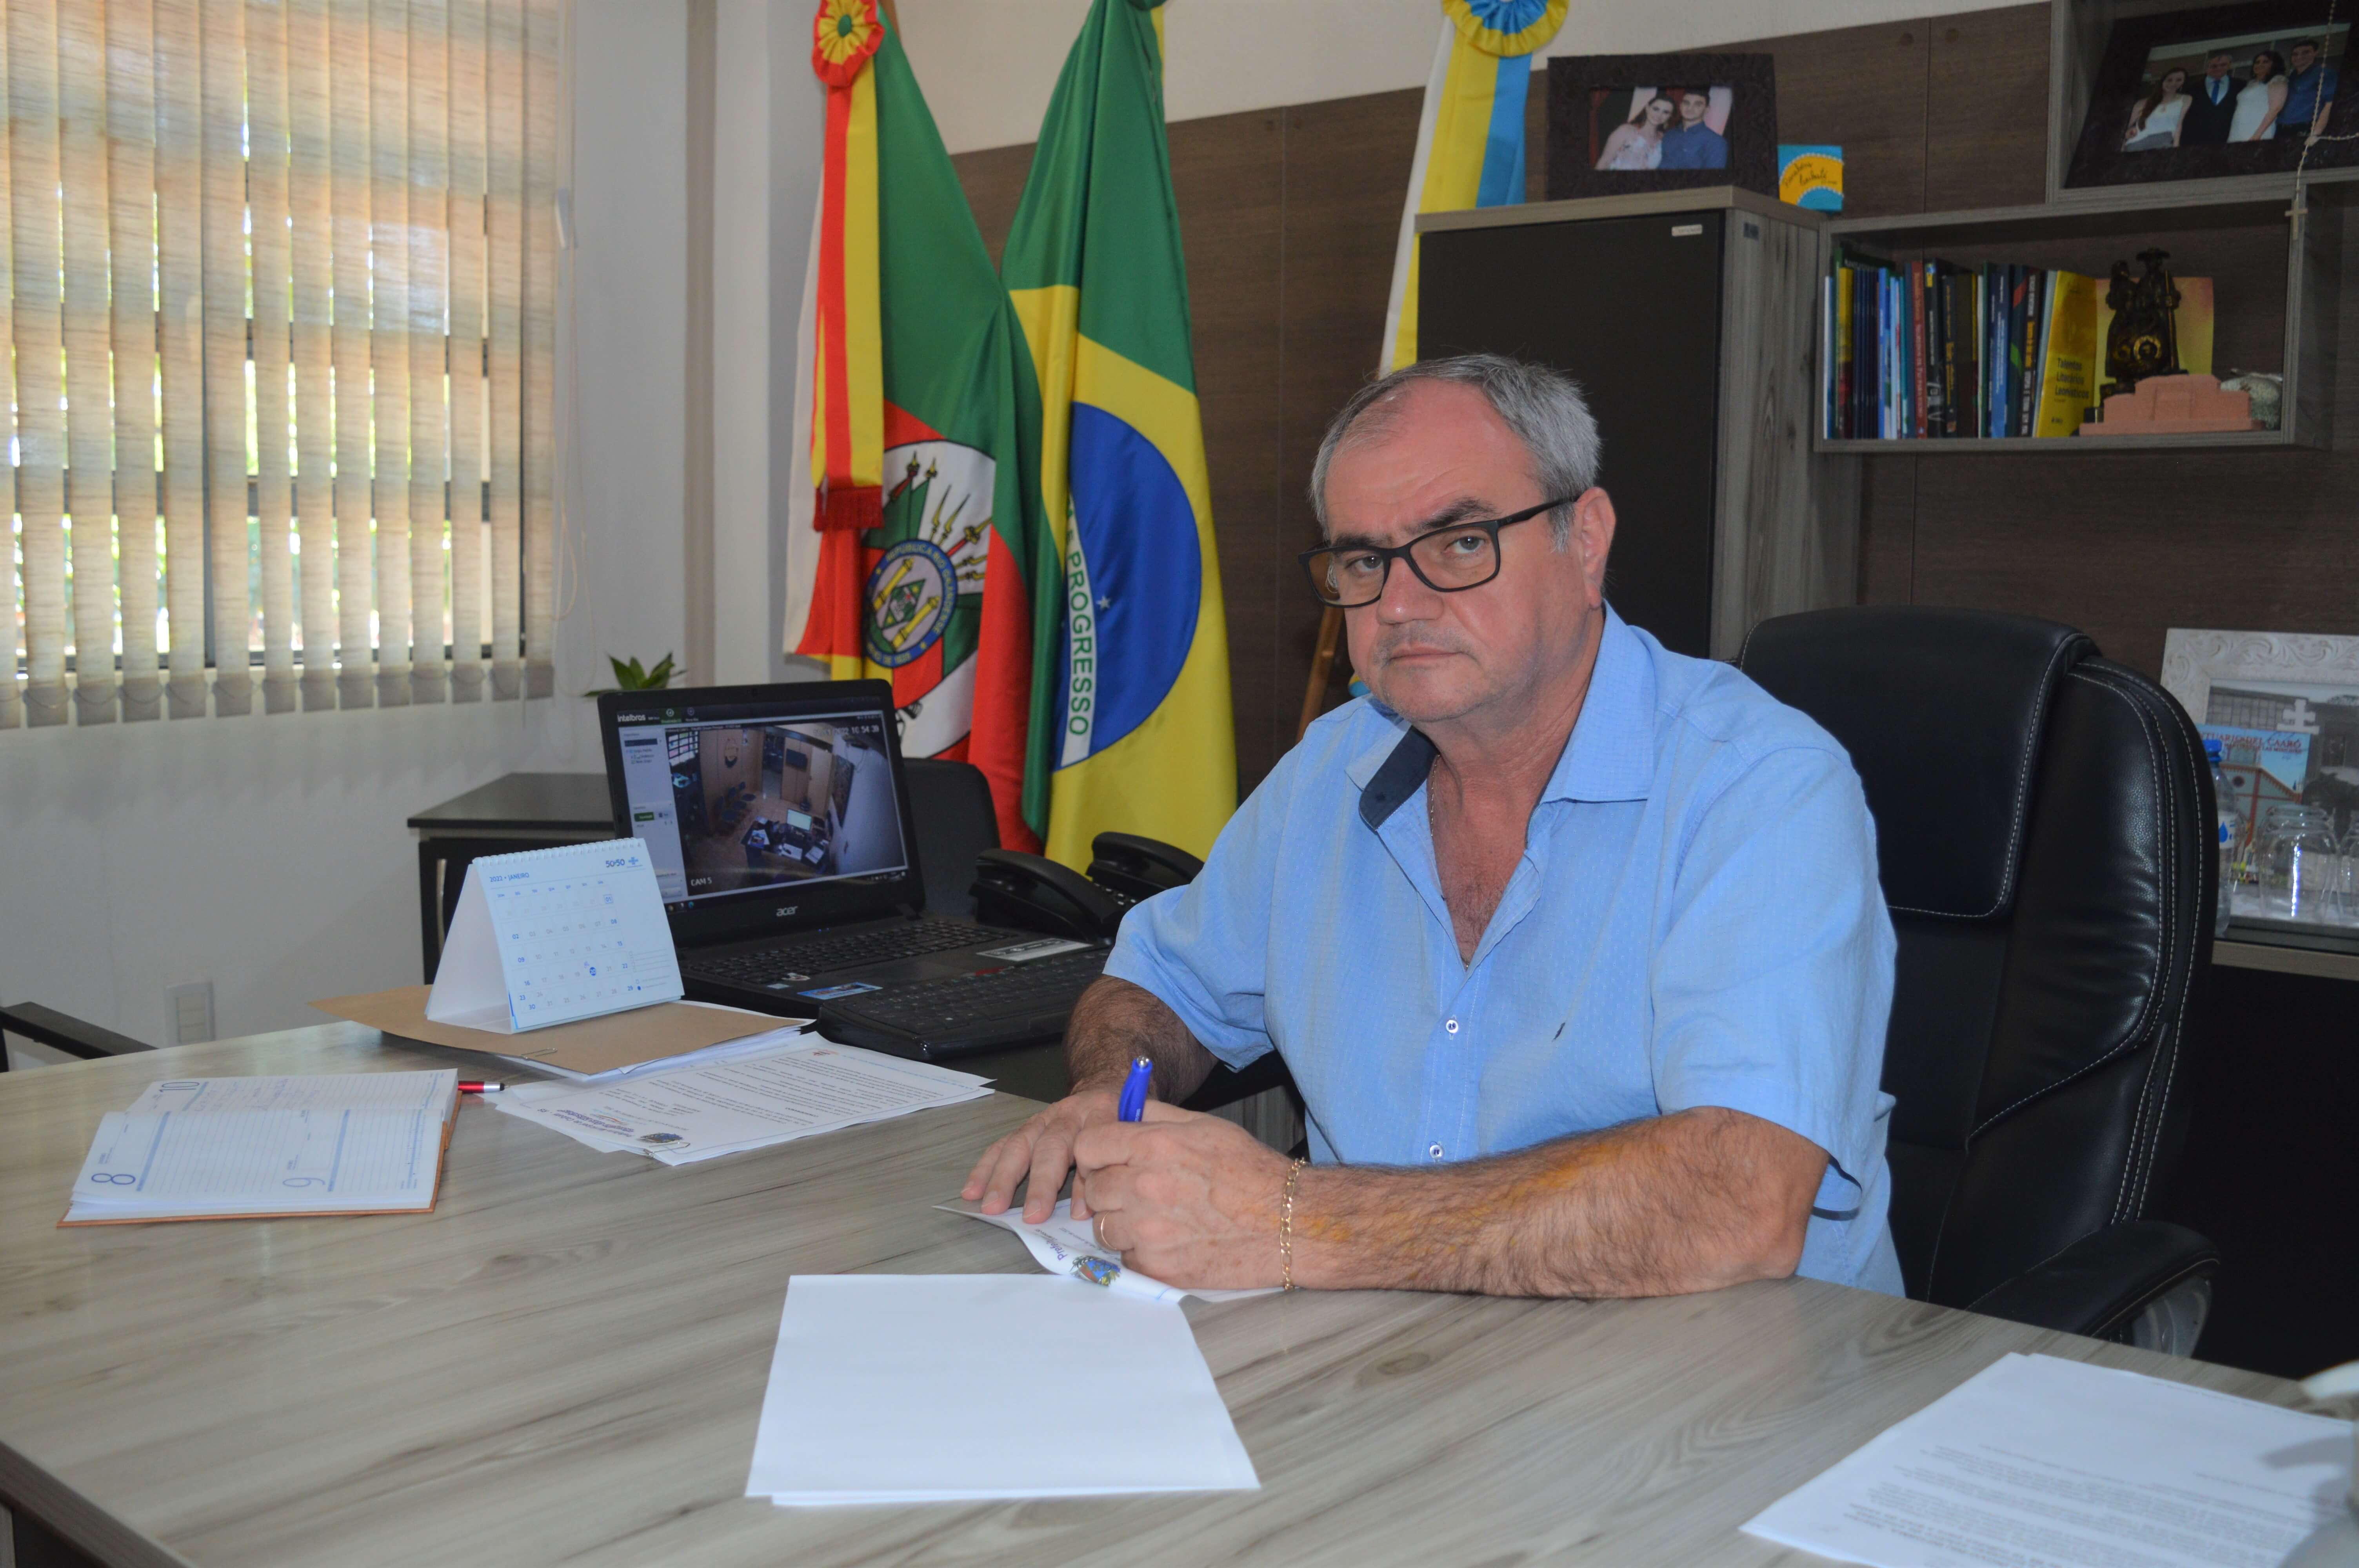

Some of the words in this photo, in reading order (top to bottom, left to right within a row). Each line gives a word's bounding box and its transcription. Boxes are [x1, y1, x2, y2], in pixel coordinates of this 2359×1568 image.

[1067, 551, 1093, 736] PROGRESSO
[508, 872, 530, 881] JANEIRO
[691, 877, 706, 886] CAM
[776, 906, 798, 917] acer
[159, 1081, 200, 1093] 10
[91, 1173, 136, 1185] 8
[282, 1177, 326, 1188] 9
